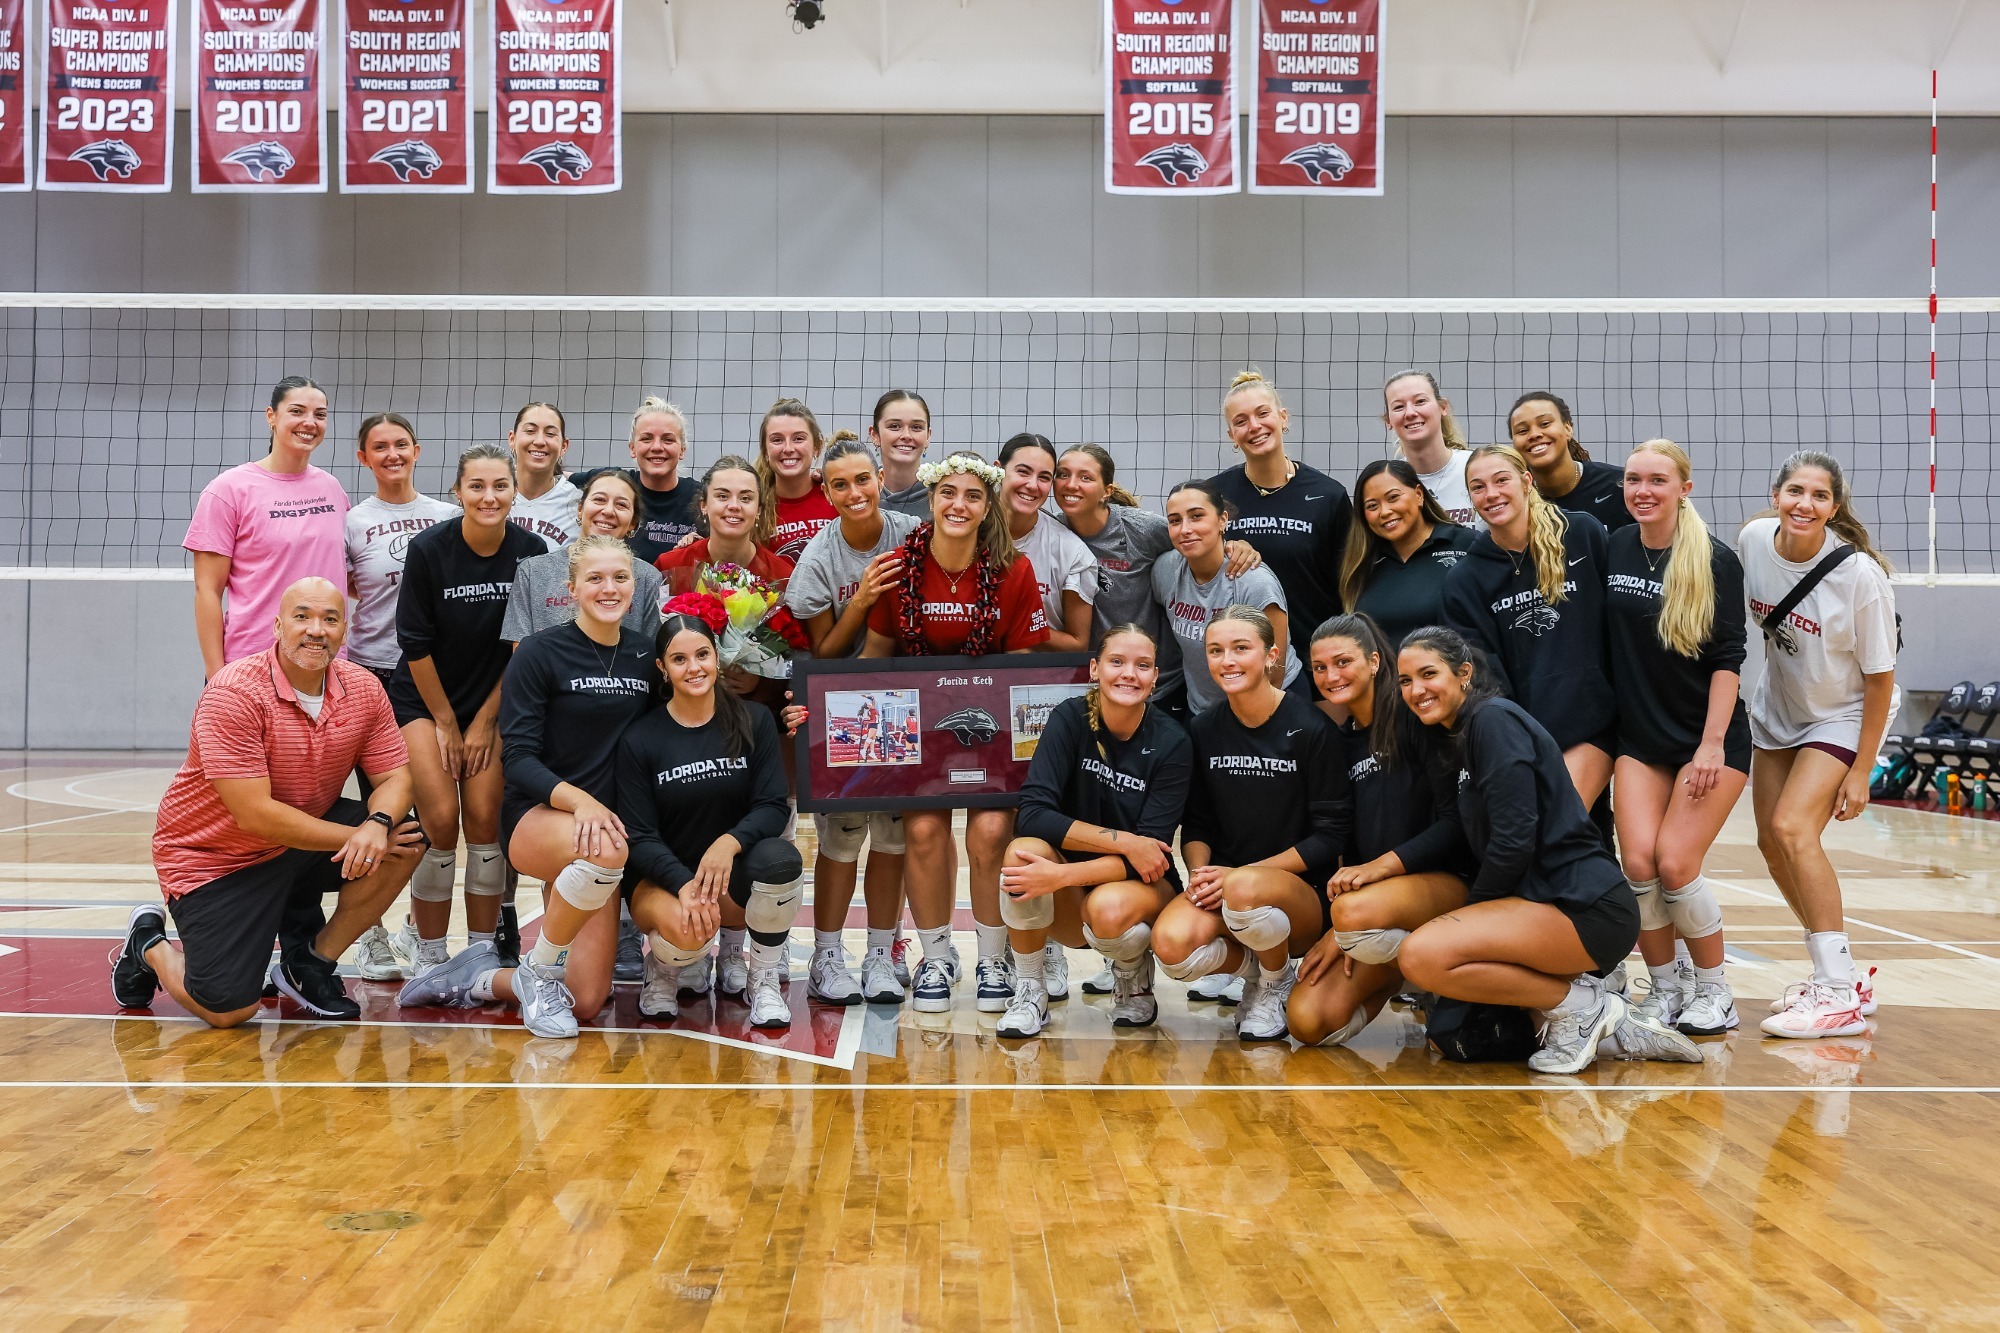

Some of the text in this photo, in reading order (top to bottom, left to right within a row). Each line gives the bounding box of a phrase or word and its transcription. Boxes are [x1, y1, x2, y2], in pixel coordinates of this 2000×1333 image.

[72, 7, 148, 22] NCAA DIV. II
[220, 8, 253, 22] NCAA
[368, 9, 444, 23] NCAA DIV. II
[518, 9, 592, 24] NCAA DIV. II
[1134, 12, 1209, 25] NCAA DIV. II
[1281, 10, 1356, 24] NCAA DIV. II
[52, 27, 164, 51] SUPER REGION II
[204, 30, 314, 51] SOUTH REGION
[349, 31, 460, 50] SOUTH REGION
[499, 31, 609, 51] SOUTH REGION
[1116, 34, 1227, 53] SOUTH REGION II
[1263, 33, 1374, 53] SOUTH REGION II
[66, 53, 148, 73] CHAMPIONS
[214, 53, 305, 73] CHAMPIONS
[360, 53, 450, 73] CHAMPIONS
[509, 53, 600, 73] CHAMPIONS
[1131, 56, 1213, 75] CHAMPIONS
[1278, 56, 1359, 75] CHAMPIONS
[71, 77, 141, 90] MENS SOCCER
[215, 79, 304, 91] WOMENS SOCCER
[360, 79, 449, 90] WOMENS SOCCER
[510, 80, 599, 91] WOMENS SOCCER
[1146, 81, 1198, 93] SOFTBALL
[1292, 81, 1343, 93] SOFTBALL
[58, 97, 154, 132] 2023
[216, 100, 301, 133] 2010
[362, 99, 448, 132] 2021
[508, 100, 602, 134] 2023
[1129, 102, 1214, 135] 2015
[1275, 102, 1360, 135] 2019
[366, 518, 436, 544] FLORID
[537, 520, 569, 546] TECH
[1226, 517, 1312, 534] FLORIDA TECH
[444, 582, 513, 599] FLORIDA TE
[1608, 574, 1645, 590] FLORIDA
[1614, 587, 1653, 599] VOLLEYBALL
[922, 602, 965, 614] ORIDA
[1789, 611, 1821, 638] TECH
[570, 677, 650, 693] FLORIDA TECH
[936, 676, 993, 687] Florida Tech
[594, 688, 636, 696] VOLLEYBALL
[657, 759, 717, 785] FLORIDA
[1210, 756, 1297, 772] FLORIDA TECH
[682, 771, 731, 784] VOLLEYBALL
[1116, 772, 1146, 792] TECH
